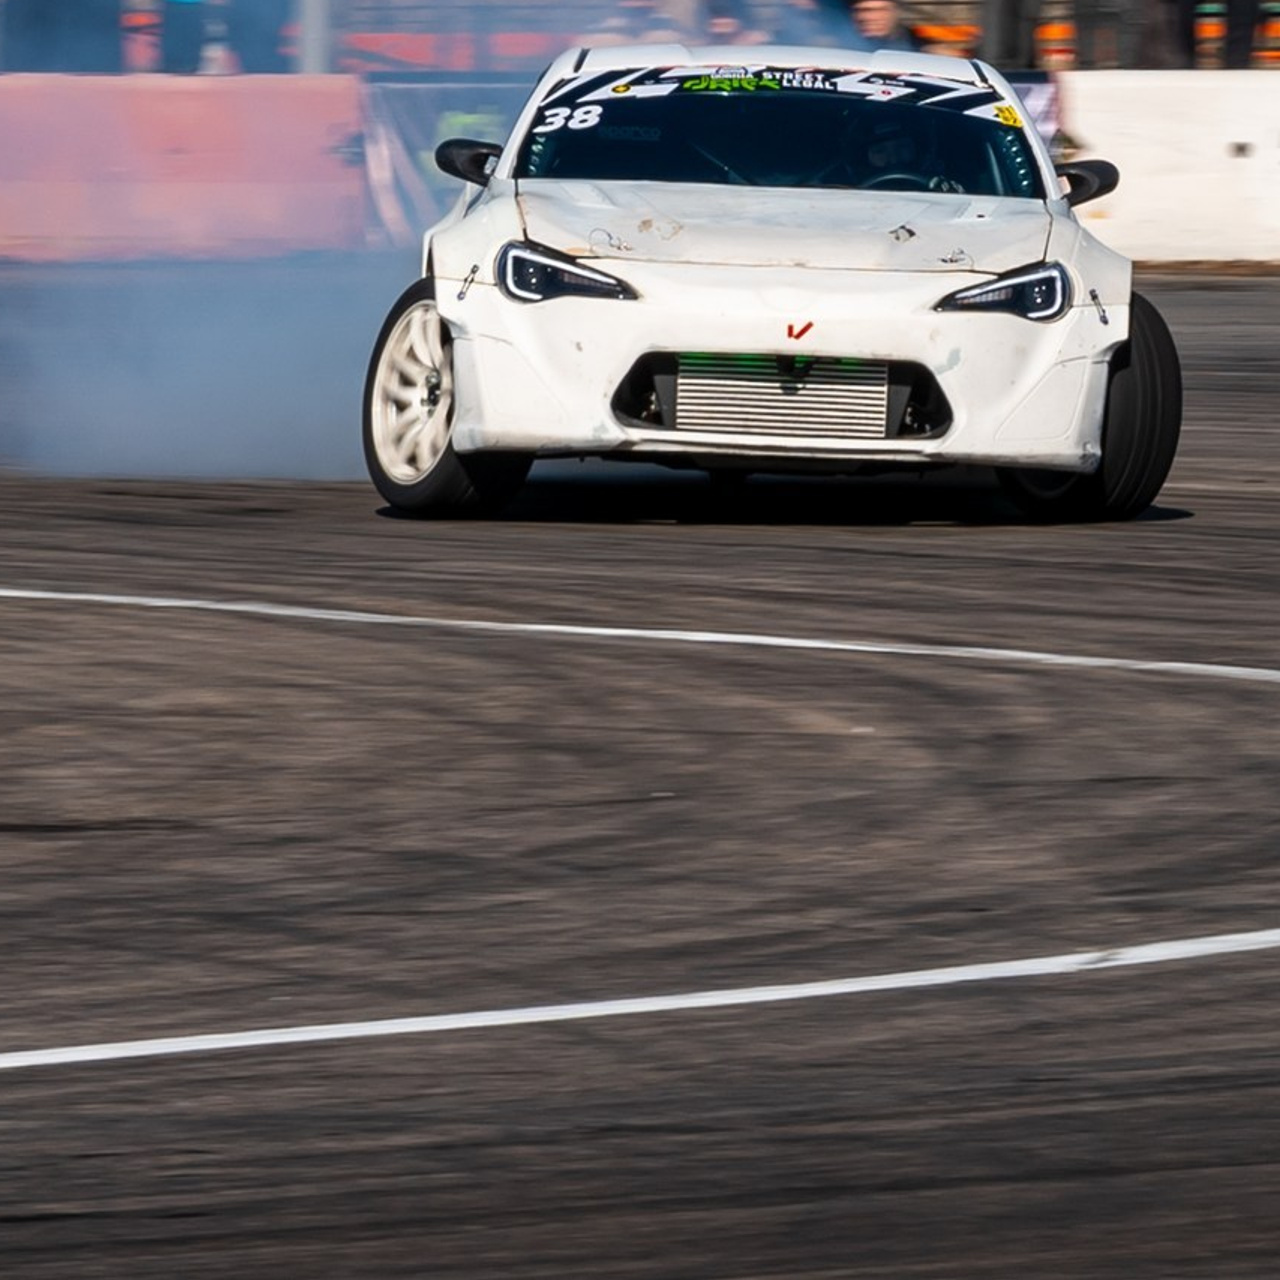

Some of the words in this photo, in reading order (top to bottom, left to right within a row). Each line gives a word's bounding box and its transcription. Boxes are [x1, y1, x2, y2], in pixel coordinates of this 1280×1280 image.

[762, 72, 825, 82] STREET
[782, 78, 835, 90] LEGAL
[532, 104, 603, 133] 38
